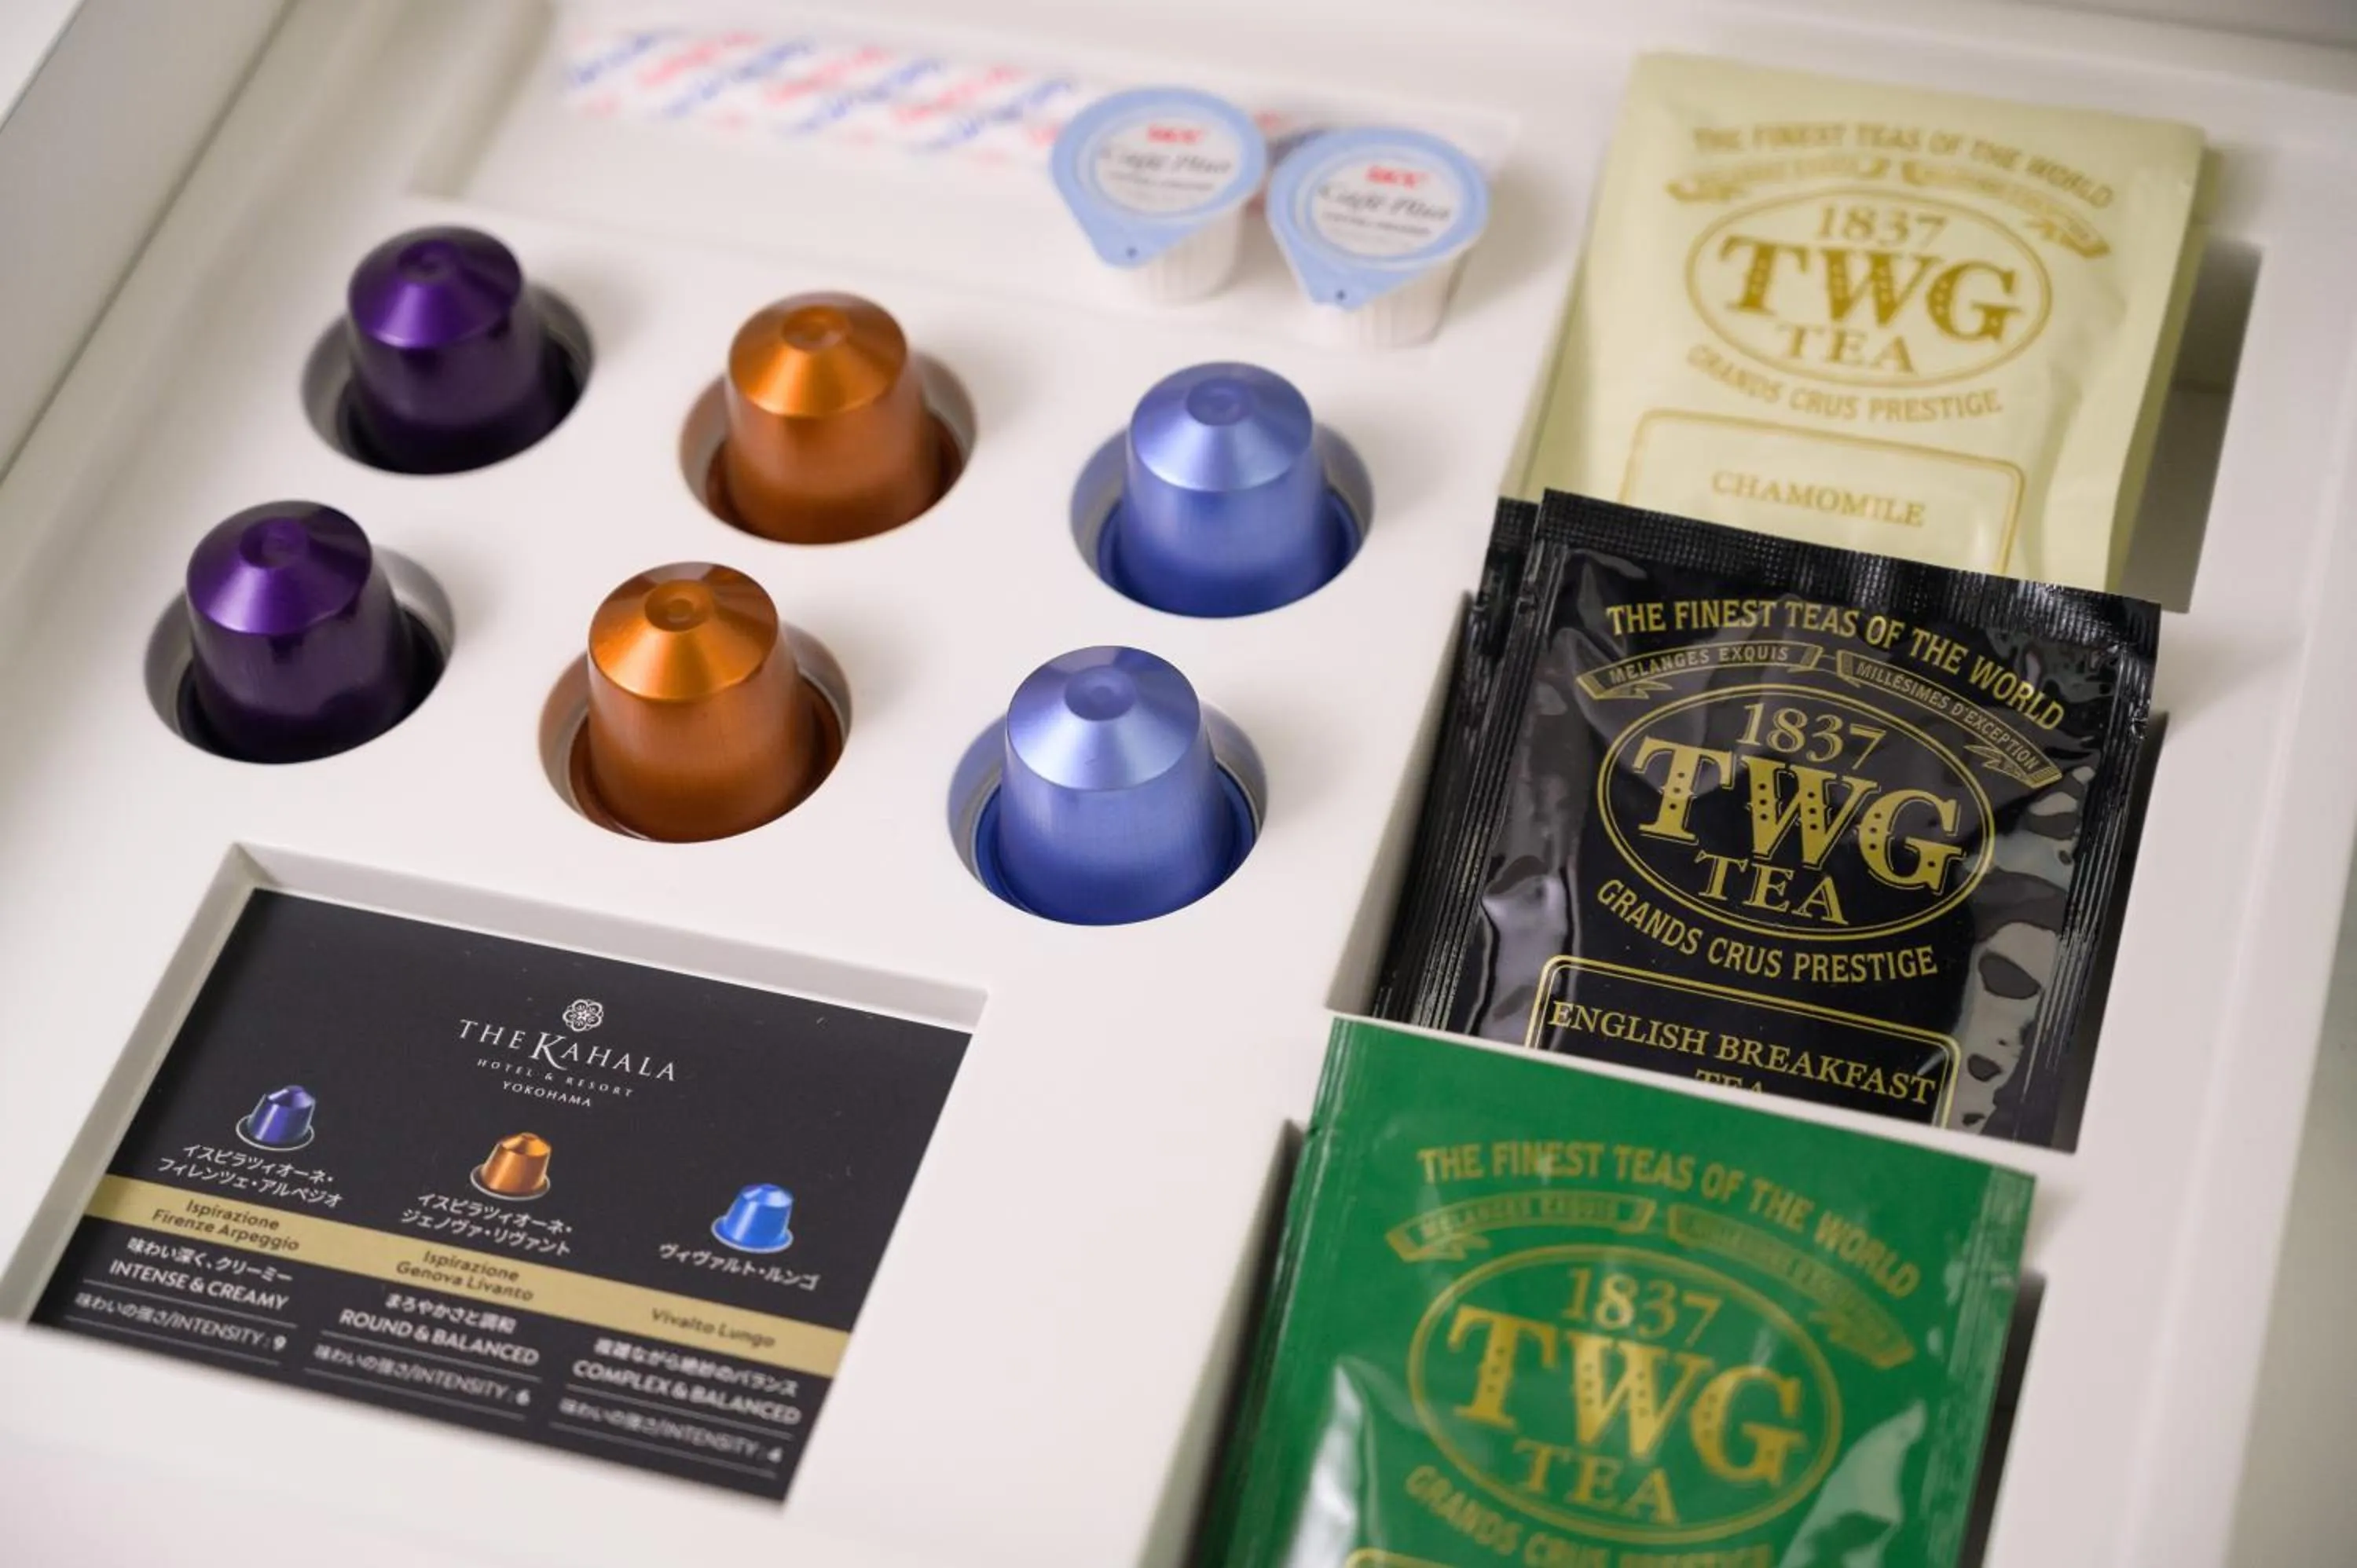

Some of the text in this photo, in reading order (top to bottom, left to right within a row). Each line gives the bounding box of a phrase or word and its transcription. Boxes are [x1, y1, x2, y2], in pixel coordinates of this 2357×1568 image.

[1816, 202, 1948, 249] 1837
[1719, 234, 2024, 344] TWG
[1780, 319, 1922, 377] TEA
[1686, 344, 2003, 423] GRANDS CRUS PRESTIGE
[1712, 471, 1927, 529] CHAMOMILE
[1606, 599, 2065, 731] THE FINEST TEAS OF THE WORLD
[1609, 645, 1789, 685] MELANGES EXQUIS
[1736, 702, 1886, 771] 1837
[1950, 702, 2040, 771] D'EXCEPTION
[1633, 735, 1967, 896] TWG
[1695, 849, 1849, 925] TEA
[1596, 878, 1938, 984] GRANDS CRUS PRESTIGE
[459, 1019, 676, 1082] THE KAHALA
[476, 1057, 634, 1097] HOTEL & RESORT
[1548, 1000, 1937, 1106] ENGLISH BREAKFAST
[502, 1080, 592, 1108] YOKOHAMA
[152, 1208, 300, 1253] Firenze Arpeggio
[185, 1199, 280, 1231] Ispirazione
[1417, 1140, 1921, 1299] THE FINEST TEAS OF THE WORLD
[108, 1259, 290, 1310] INTENSE & CREAMY
[396, 1260, 534, 1302] Genova Livanto
[423, 1251, 519, 1282] Ispirazione
[659, 1243, 821, 1291] ヴィヴァルト・ルンゴ
[339, 1308, 540, 1367] ROUND & BALANCED
[651, 1307, 776, 1349] Vivalto Lungo
[1562, 1268, 1723, 1348] 1837
[573, 1359, 801, 1425] COMPLEX & BALANCED
[1446, 1305, 1804, 1486] TWG
[1404, 1464, 1523, 1557] GRANDS
[1512, 1438, 1681, 1526] TEA
